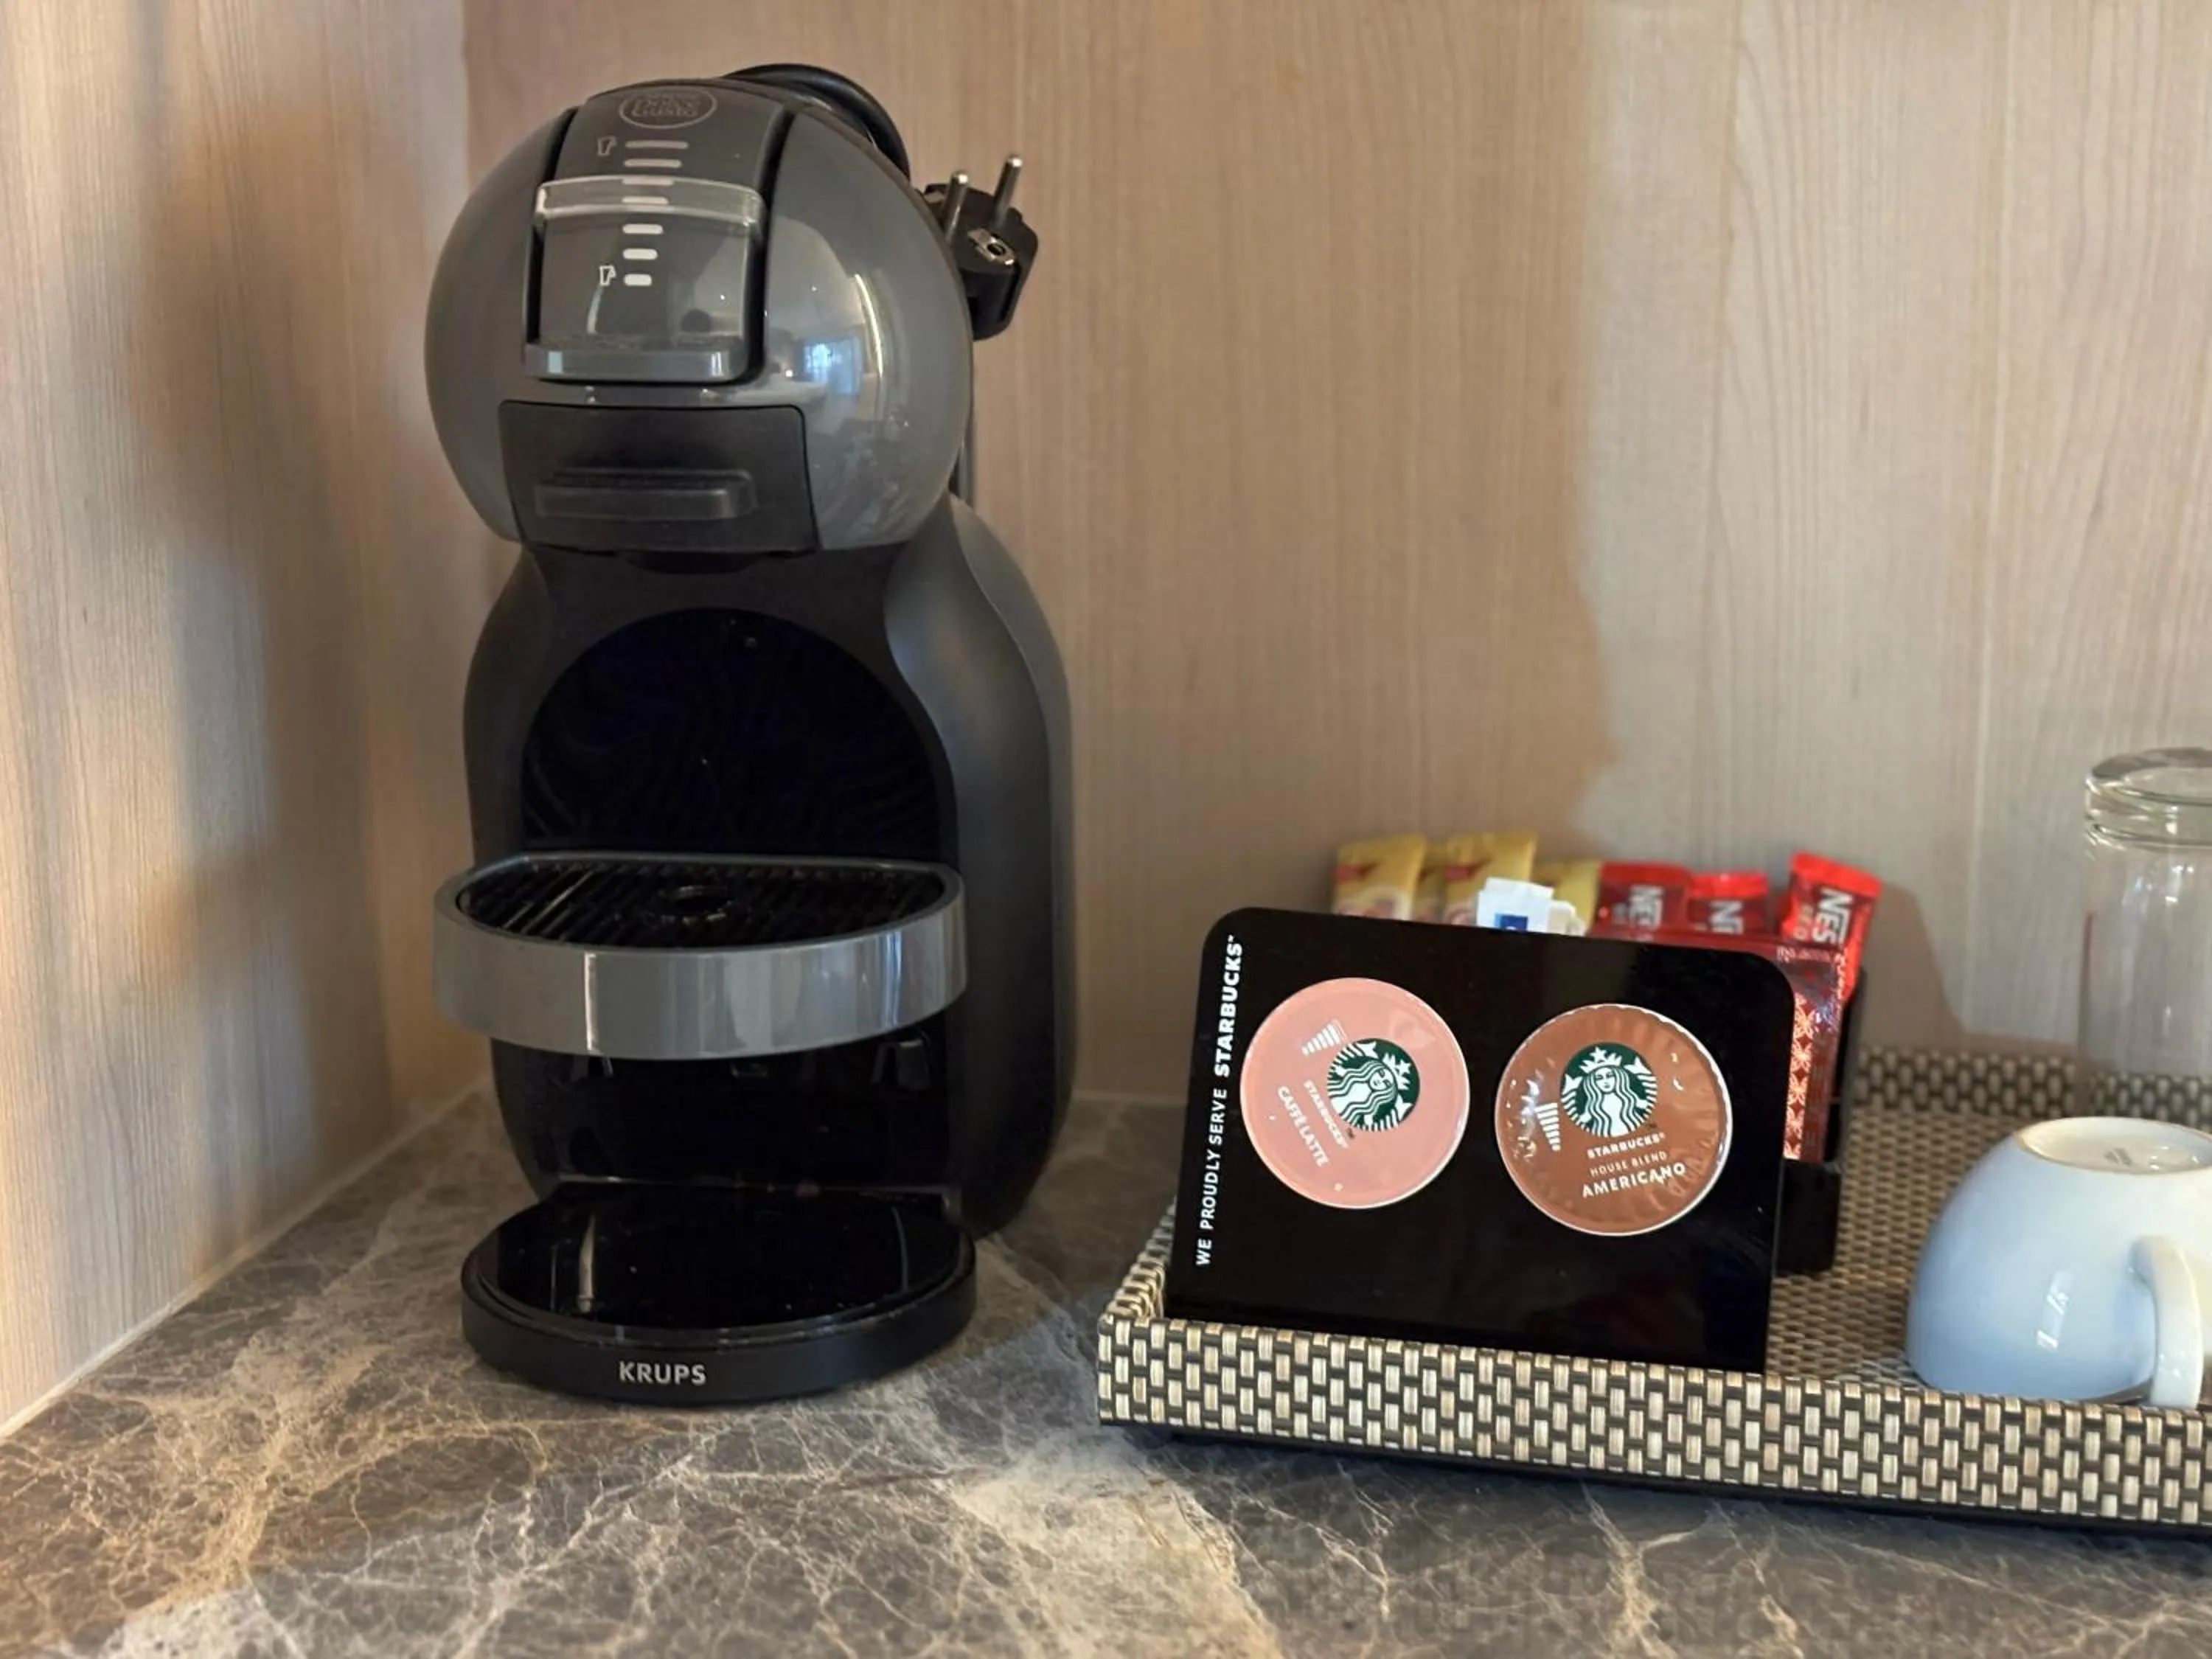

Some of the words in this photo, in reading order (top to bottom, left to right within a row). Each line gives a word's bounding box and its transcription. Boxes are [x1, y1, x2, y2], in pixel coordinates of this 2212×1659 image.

[1208, 1088, 1228, 1146] SERVE
[1299, 1126, 1329, 1166] LATTE
[1590, 1160, 1629, 1178] HOUSE
[1631, 1150, 1668, 1167] BLEND
[1200, 1148, 1221, 1230] PROUDLY
[1582, 1162, 1686, 1198] AMERICANO
[1195, 1238, 1212, 1266] WE
[619, 1360, 706, 1385] KRUPS
